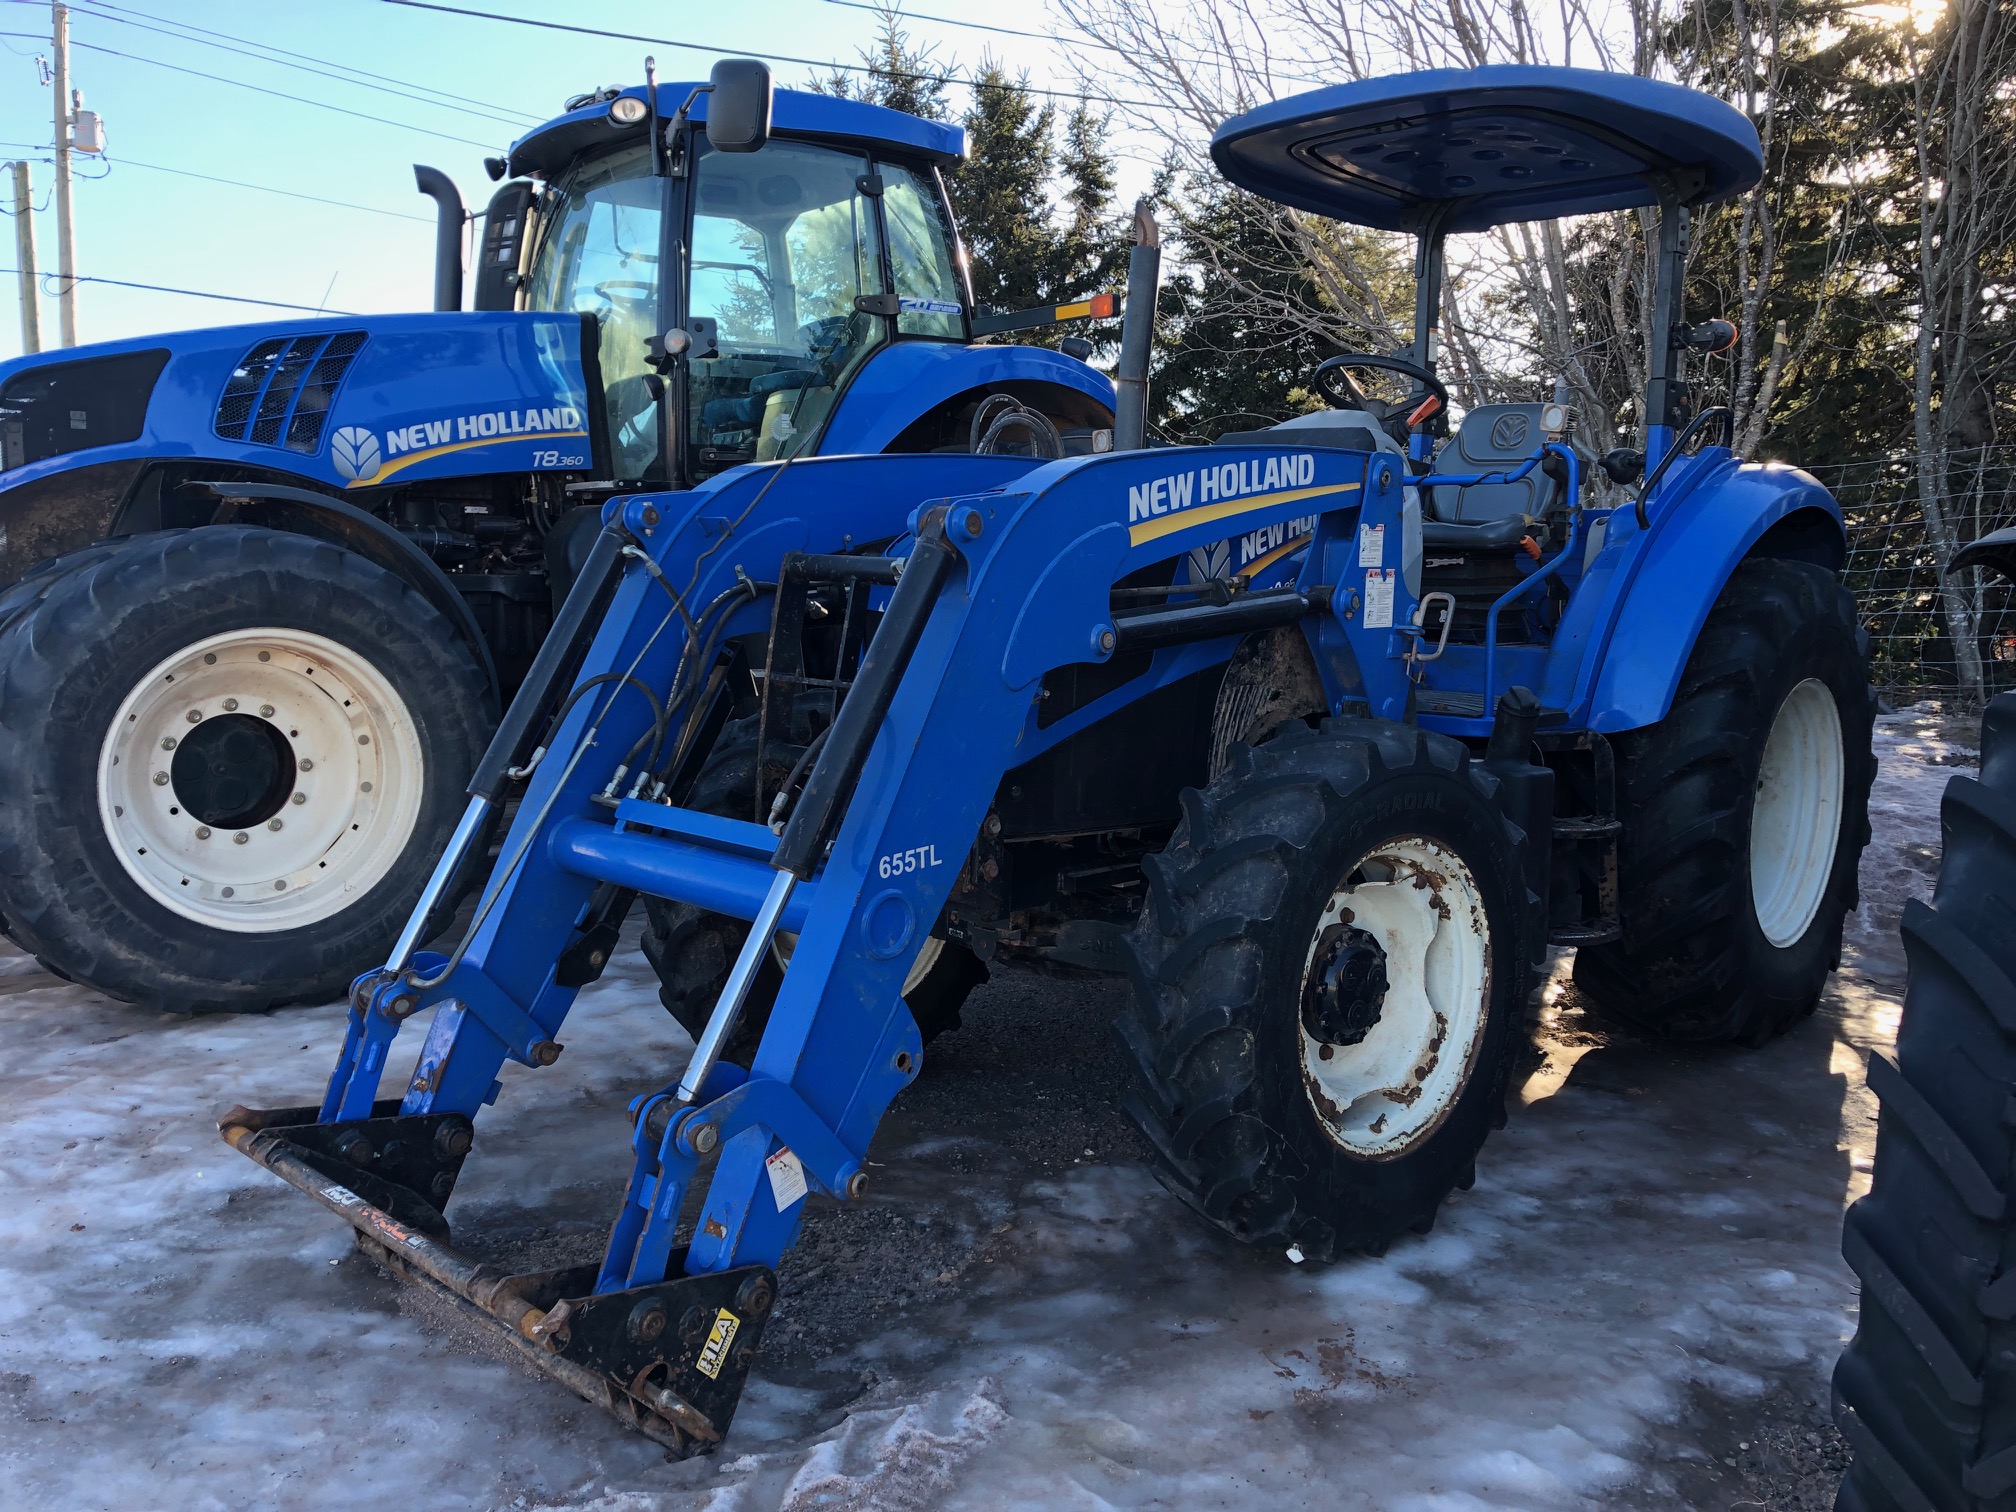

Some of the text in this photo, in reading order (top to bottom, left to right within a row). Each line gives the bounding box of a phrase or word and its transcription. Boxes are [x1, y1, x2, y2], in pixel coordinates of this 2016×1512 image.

[386, 407, 580, 454] NEW HOLLAND
[532, 450, 584, 467] T8.360
[1128, 453, 1315, 522] NEW HOLLAND
[1241, 522, 1284, 565] NEW
[878, 844, 942, 879] 655TL
[699, 1318, 734, 1371] HLA
